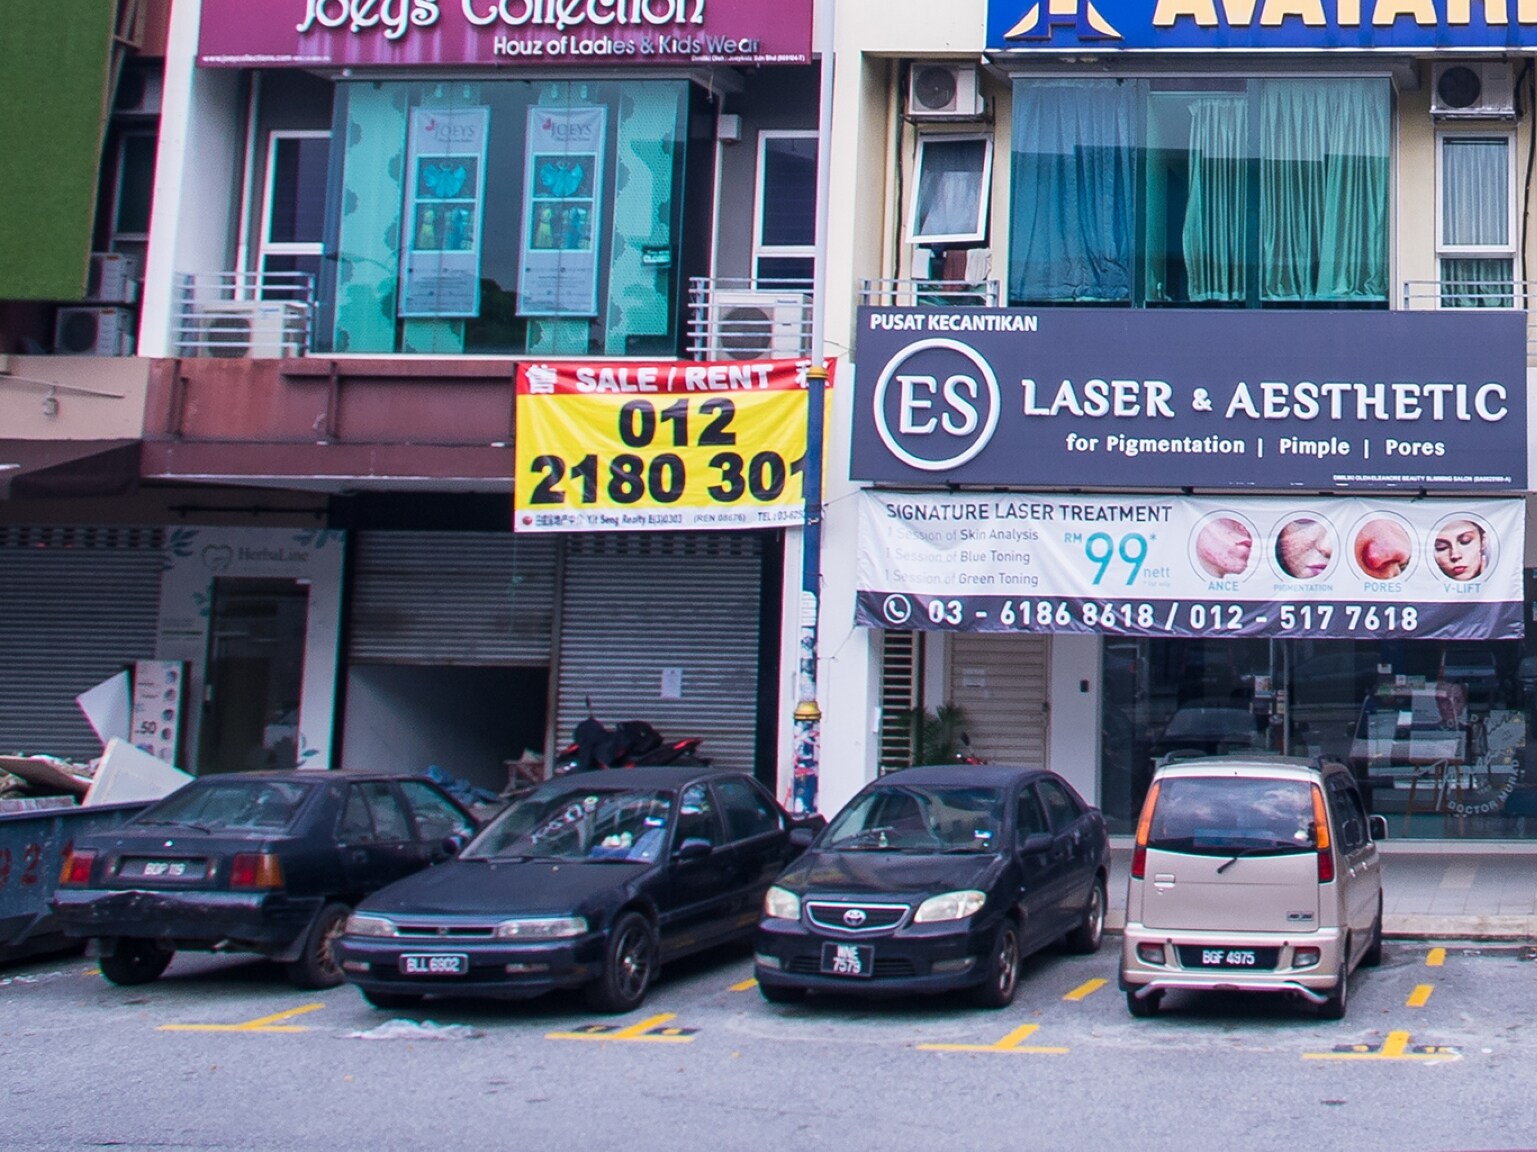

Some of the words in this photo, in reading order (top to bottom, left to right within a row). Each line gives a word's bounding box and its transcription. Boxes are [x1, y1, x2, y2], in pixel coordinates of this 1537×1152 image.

[493, 35, 543, 56] Houz
[545, 35, 569, 55] of
[570, 35, 635, 55] Ladies
[640, 37, 654, 54] &
[658, 34, 701, 55] Kids
[705, 35, 761, 55] Wear
[870, 314, 925, 331] PUSAT
[928, 314, 1038, 332] KECANTIKAN
[576, 366, 659, 393] SALE
[685, 364, 774, 391] RENT
[895, 374, 980, 436] ES
[1021, 379, 1175, 418] LASER
[1191, 387, 1213, 412] &
[1225, 381, 1508, 422] AESTHETIC
[618, 398, 737, 448] 012
[1065, 433, 1099, 452] for
[1106, 434, 1245, 456] Pigmentation
[1279, 435, 1351, 459] Pimple
[1385, 438, 1446, 457] Pores
[529, 453, 686, 505] 2180
[886, 503, 989, 521] SIGNATURE
[994, 503, 1054, 521] LASER
[1059, 505, 1173, 523] TREATMENT
[896, 528, 942, 541] Session
[959, 528, 986, 541] Skin
[989, 528, 1039, 543] Analysis
[960, 550, 987, 562] Blue
[990, 550, 1031, 565] Toning
[1064, 533, 1083, 544] RM
[1085, 532, 1149, 586] 99
[958, 573, 995, 585] Green
[998, 572, 1039, 588] Toning
[1143, 567, 1171, 578] nett
[1207, 581, 1240, 592] ANCE
[1273, 583, 1334, 593] PIGMENTATION
[1364, 582, 1402, 593] PORES
[1443, 583, 1482, 594] V-LIFT
[927, 599, 964, 625] 03
[1000, 600, 1072, 625] 6186
[1081, 602, 1154, 628] 8618
[1189, 604, 1243, 630] 012
[1280, 605, 1334, 631] 517
[1345, 605, 1419, 631] 7618
[1448, 799, 1498, 816] DOCTOR
[1226, 950, 1256, 965] 4975
